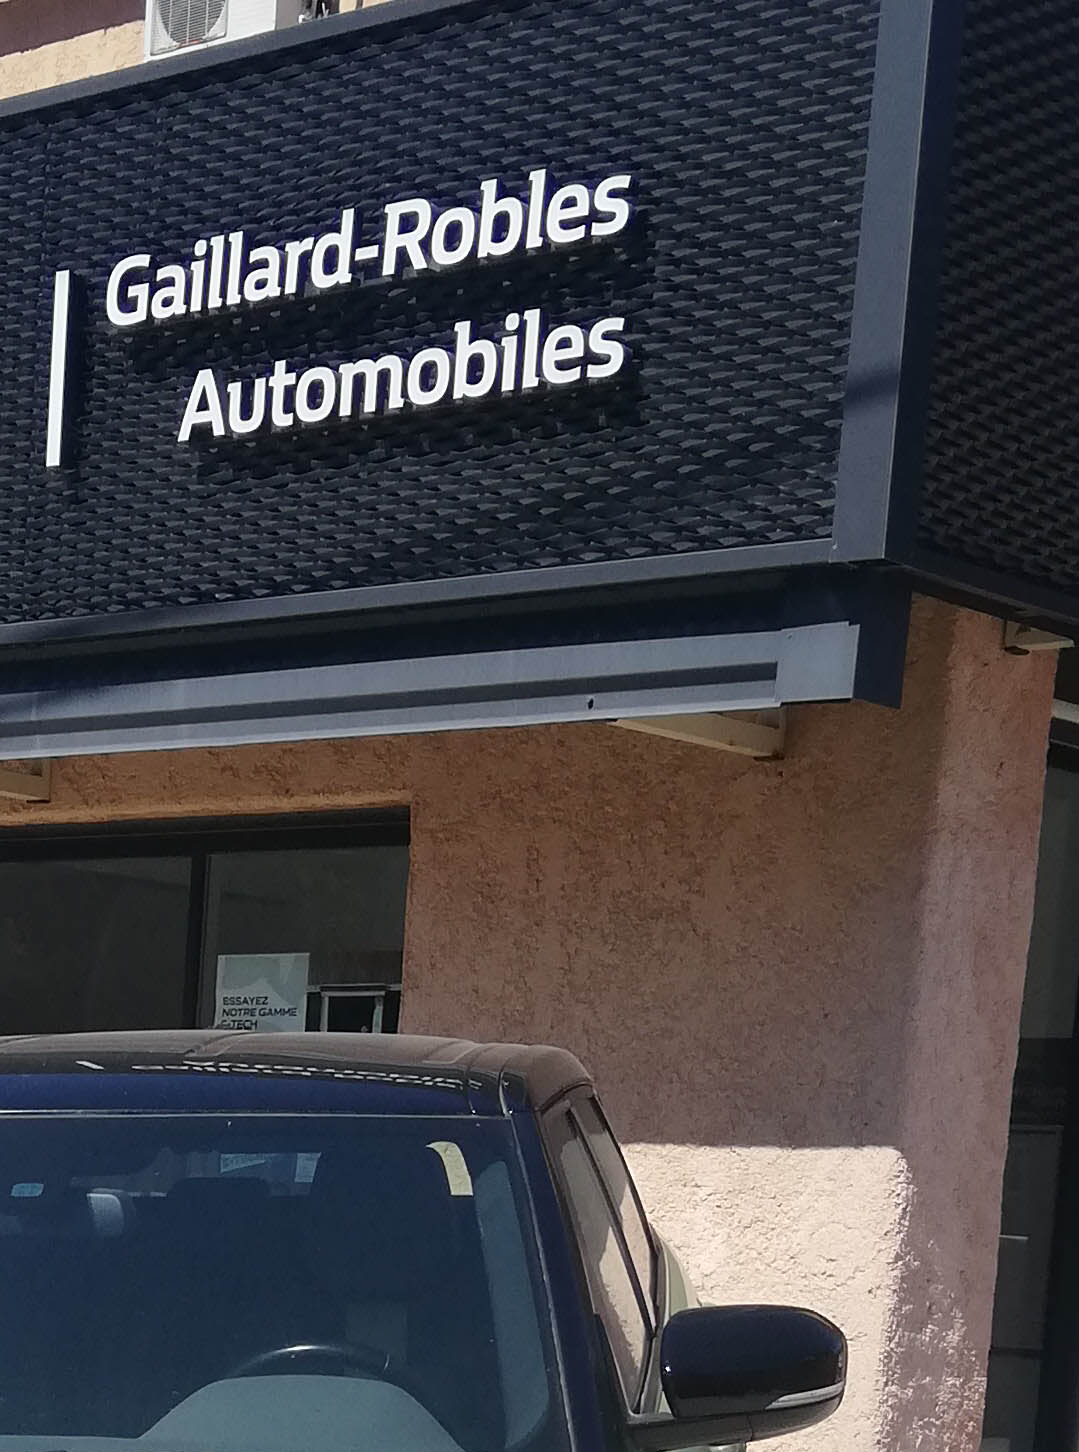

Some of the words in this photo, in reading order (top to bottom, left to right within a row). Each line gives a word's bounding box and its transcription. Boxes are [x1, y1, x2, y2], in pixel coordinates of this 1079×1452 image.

[105, 168, 632, 326] Gaillard-Robles
[177, 308, 625, 442] Automobiles
[222, 996, 268, 1006] ESSAYEZ
[222, 1008, 257, 1017] NOTRE
[258, 1008, 298, 1017] GAMME
